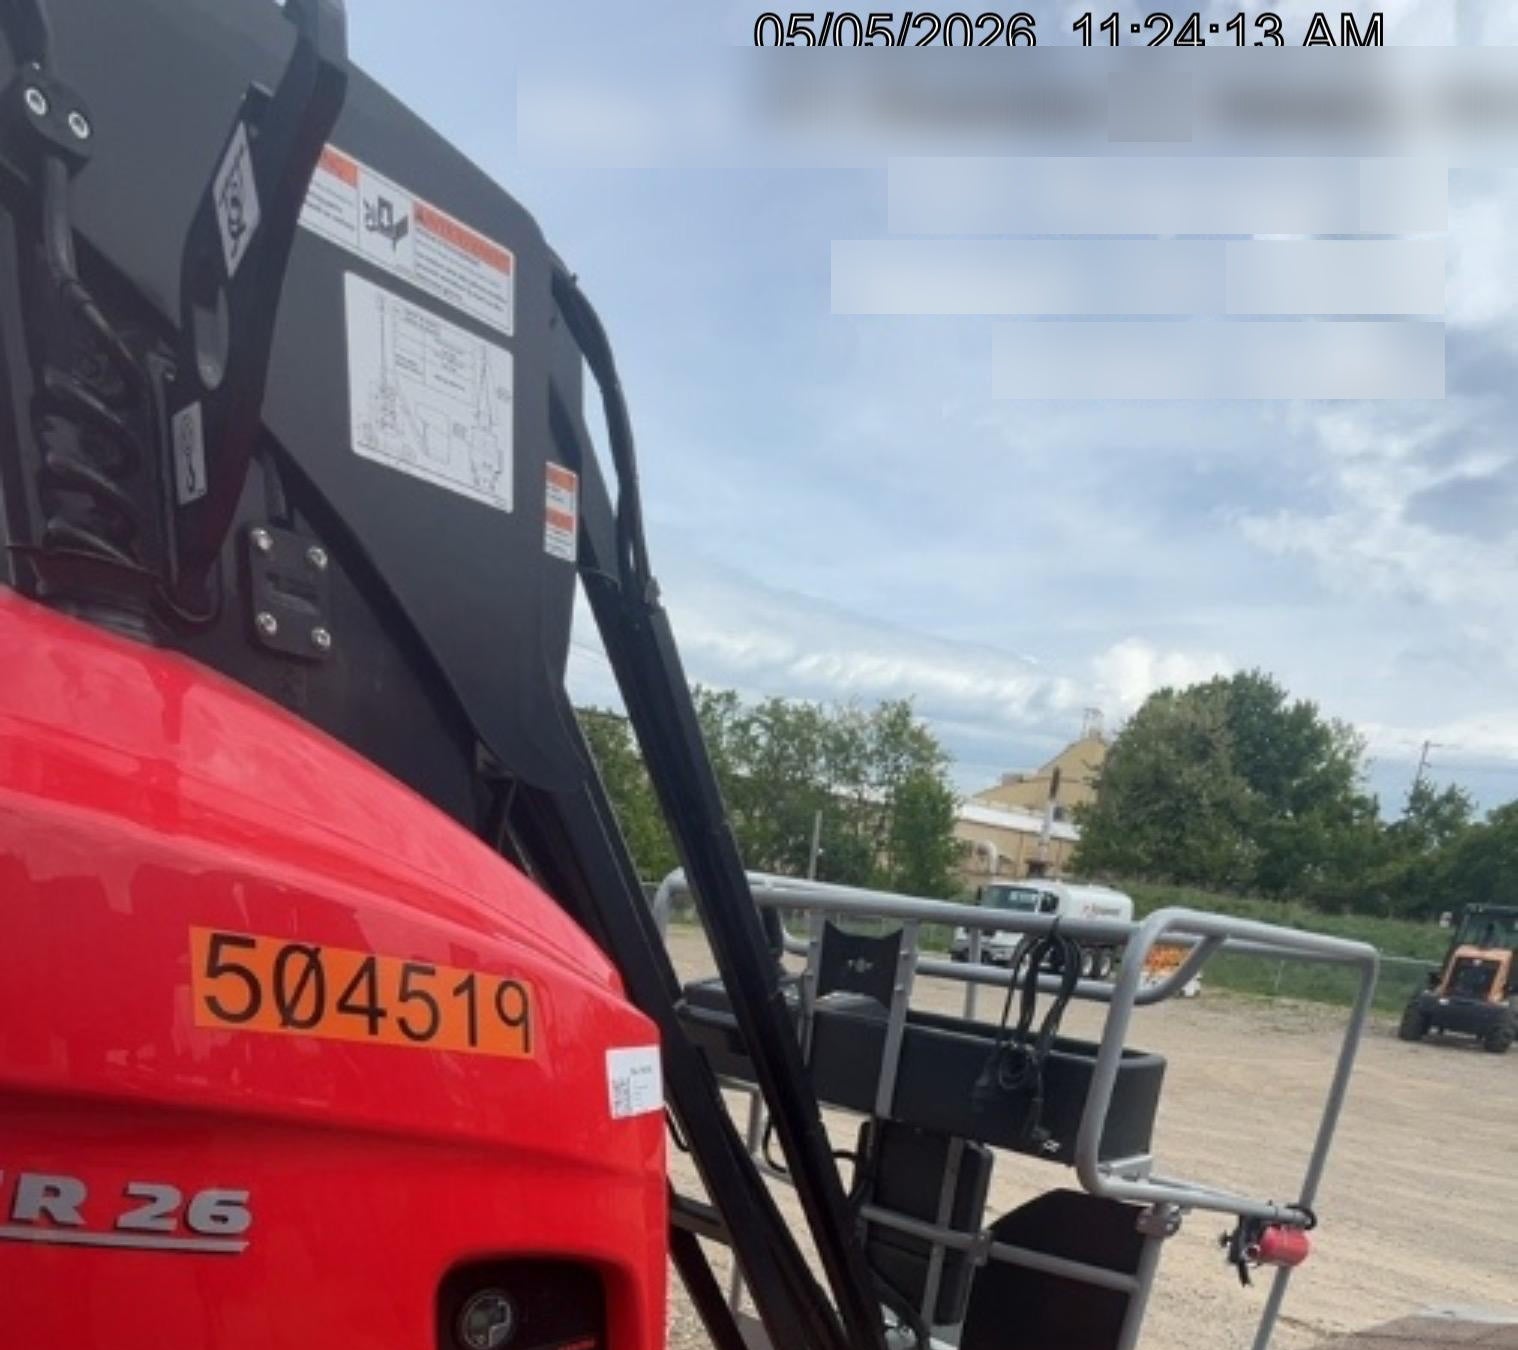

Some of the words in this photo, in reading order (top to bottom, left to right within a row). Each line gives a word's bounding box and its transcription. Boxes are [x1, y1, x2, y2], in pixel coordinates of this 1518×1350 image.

[204, 933, 531, 1053] 504519
[0, 1169, 88, 1226] R
[116, 1181, 252, 1235] 26
